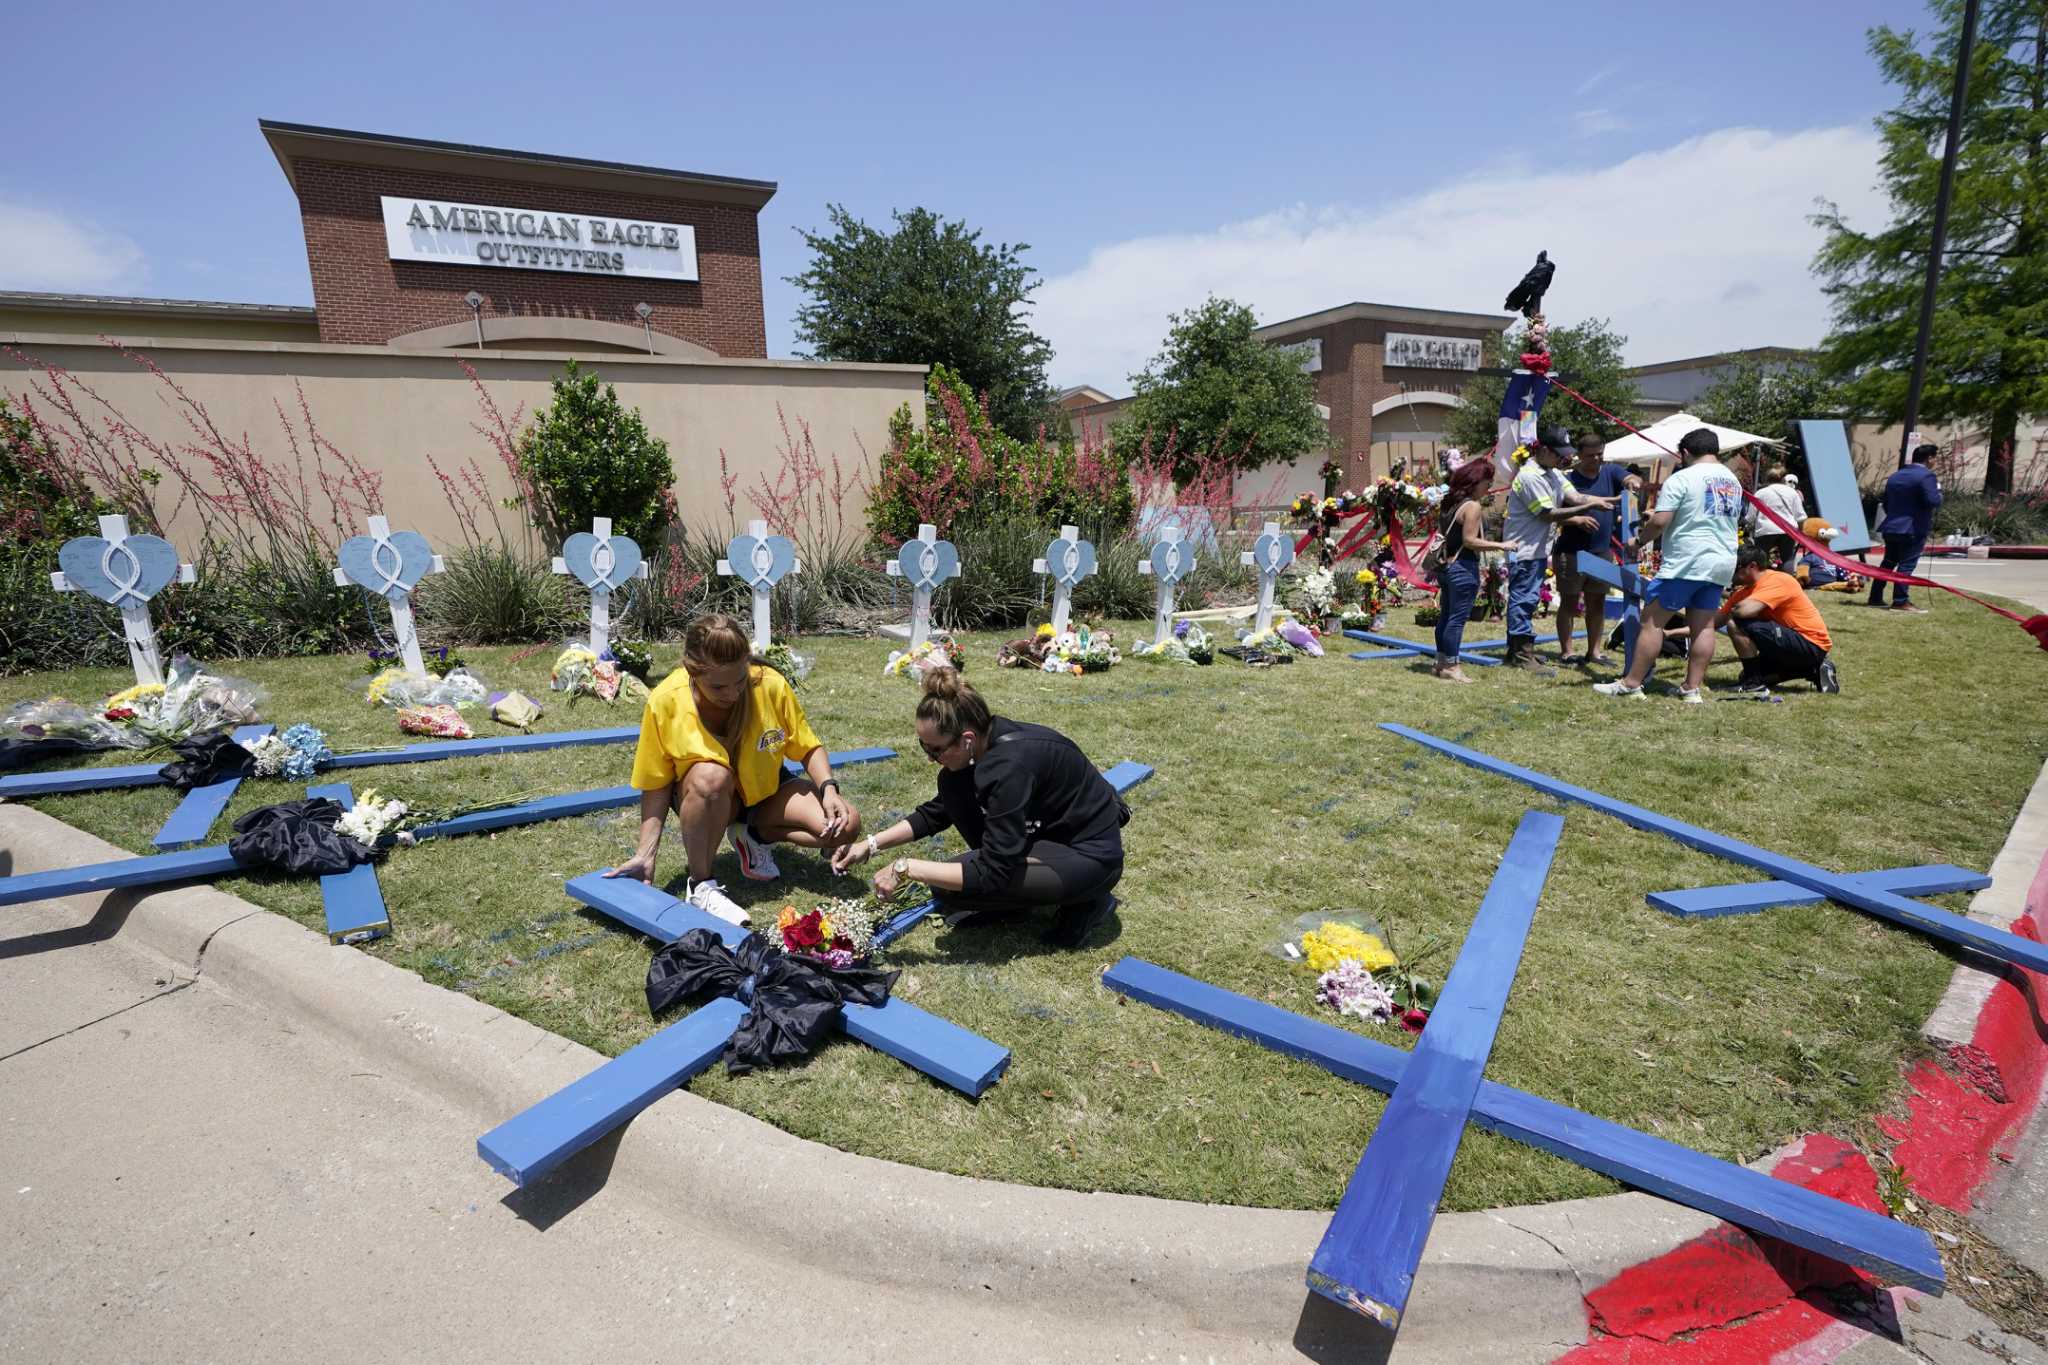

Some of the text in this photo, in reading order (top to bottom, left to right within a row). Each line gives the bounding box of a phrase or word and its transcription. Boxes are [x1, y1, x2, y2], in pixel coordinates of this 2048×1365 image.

[406, 202, 681, 250] AMERICAN EAGLE
[477, 241, 625, 271] OUTFITTERS
